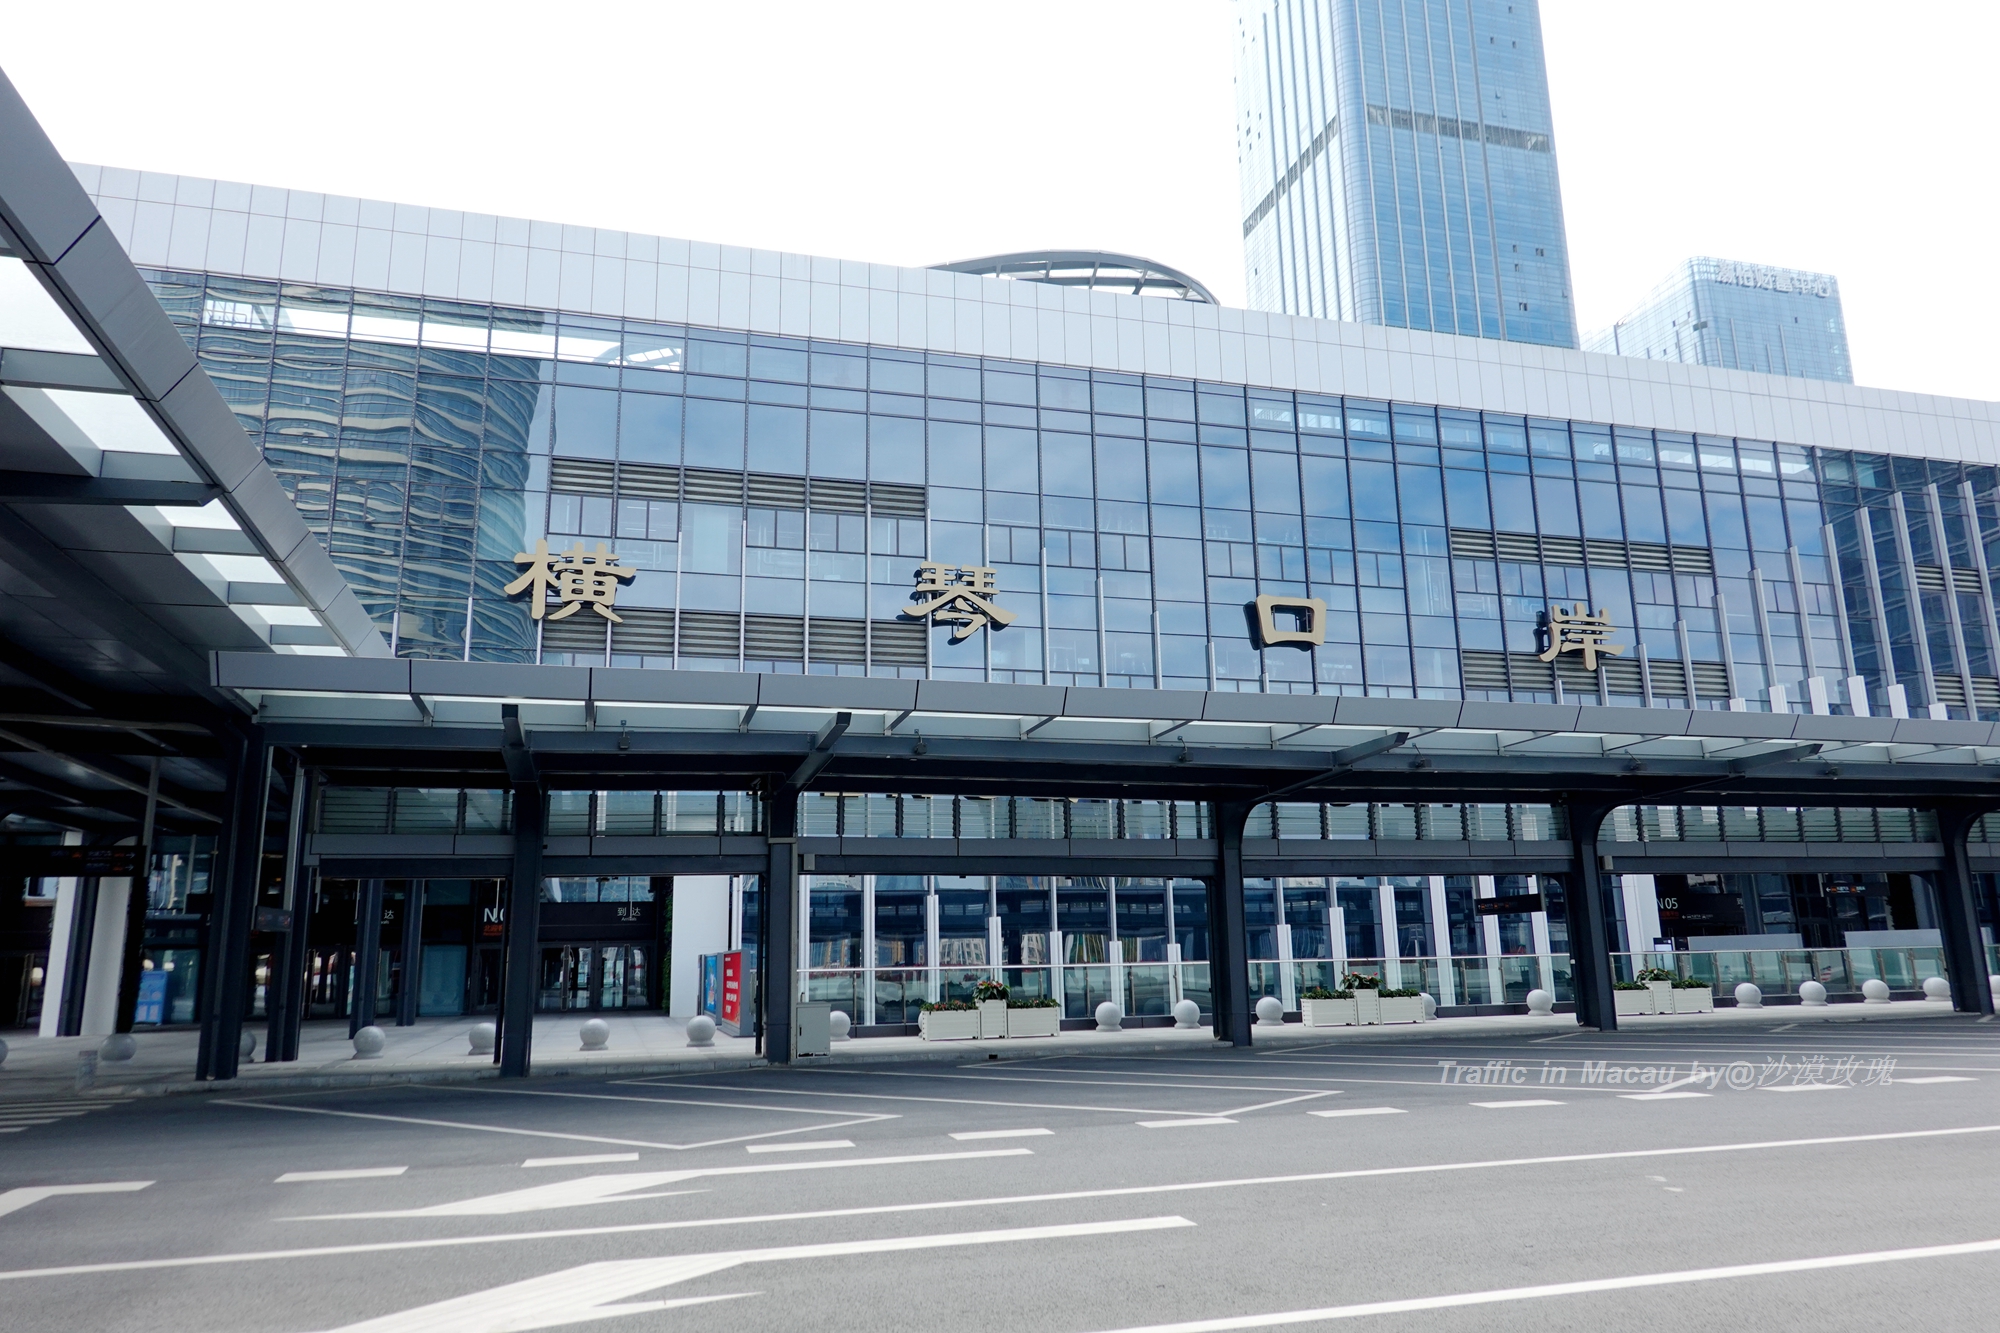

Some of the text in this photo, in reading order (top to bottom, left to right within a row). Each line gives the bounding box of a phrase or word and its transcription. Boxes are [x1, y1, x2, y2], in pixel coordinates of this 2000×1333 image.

[504, 538, 1625, 671] 横琴口岸
[1657, 897, 1679, 910] N05
[617, 907, 641, 917] 到达
